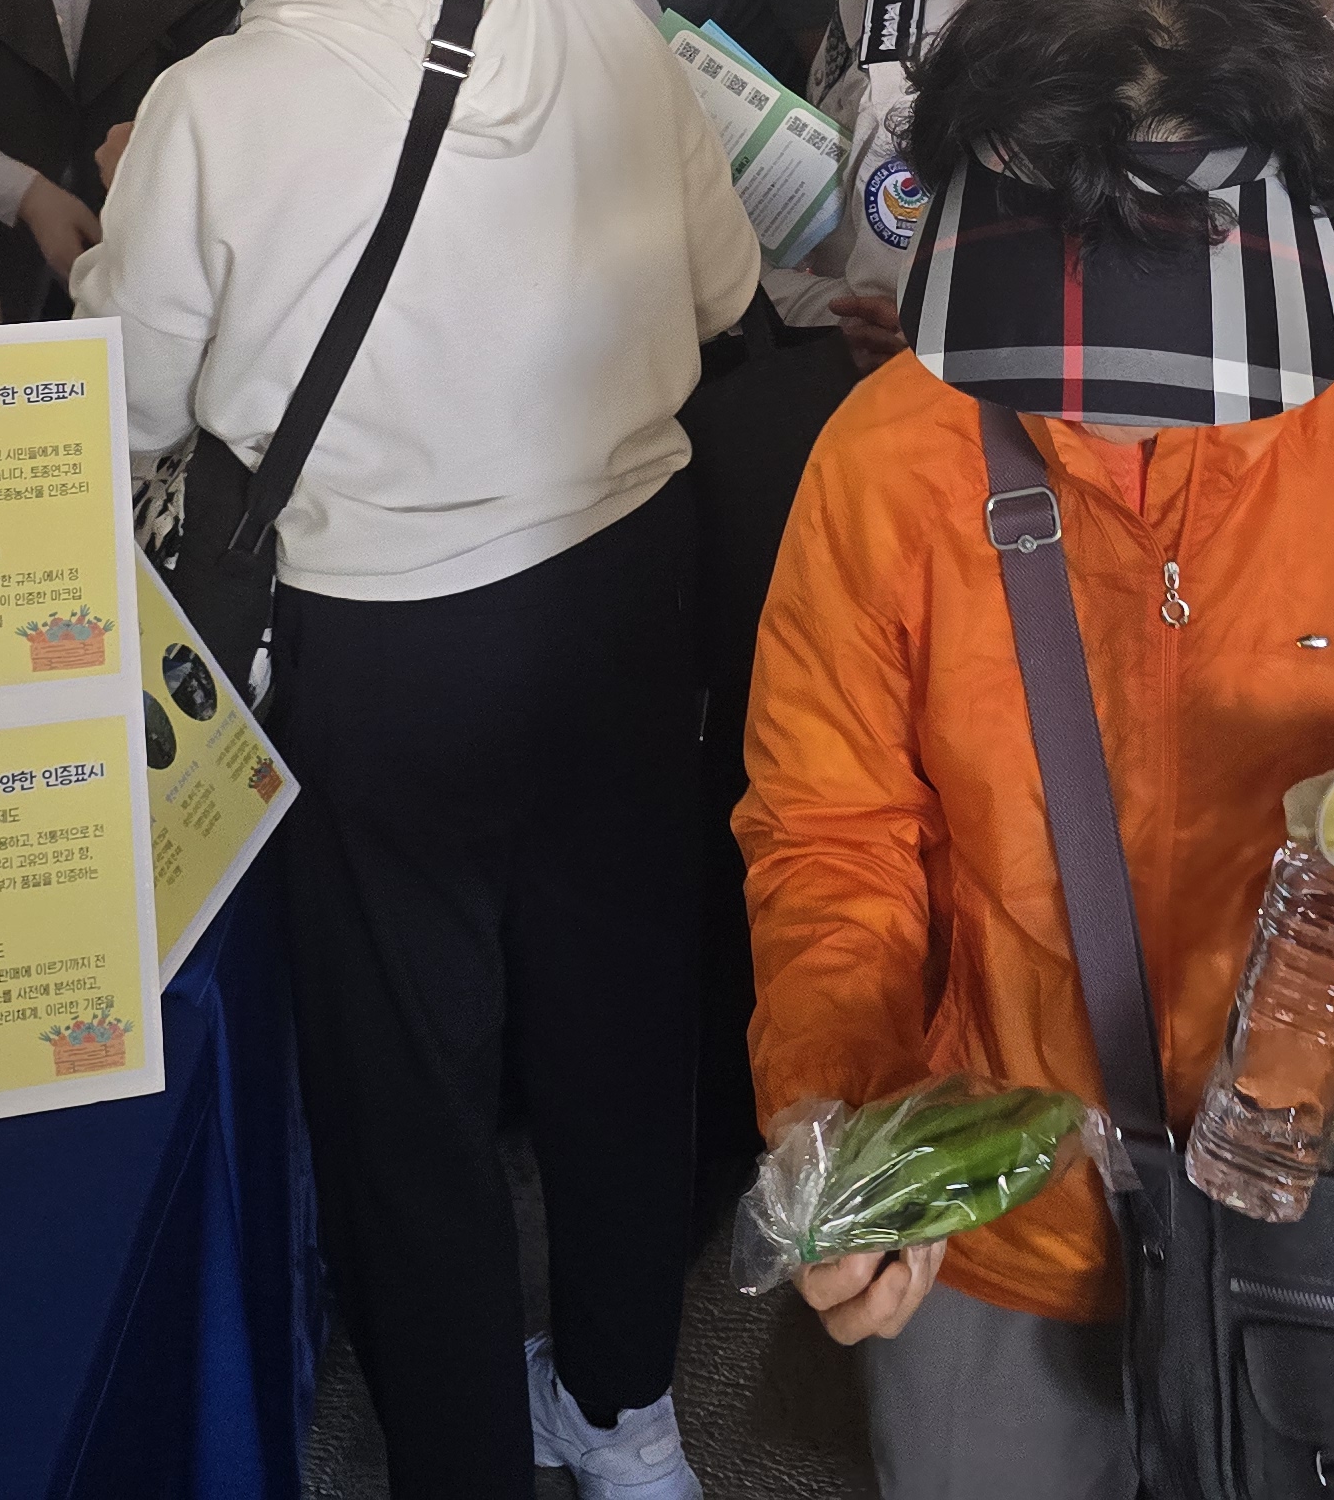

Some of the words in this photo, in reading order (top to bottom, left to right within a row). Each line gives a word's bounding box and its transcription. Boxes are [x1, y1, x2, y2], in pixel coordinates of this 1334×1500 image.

[23, 382, 85, 404] 인증표시
[30, 462, 82, 479] 토종연구회
[41, 762, 105, 788] 인증표시
